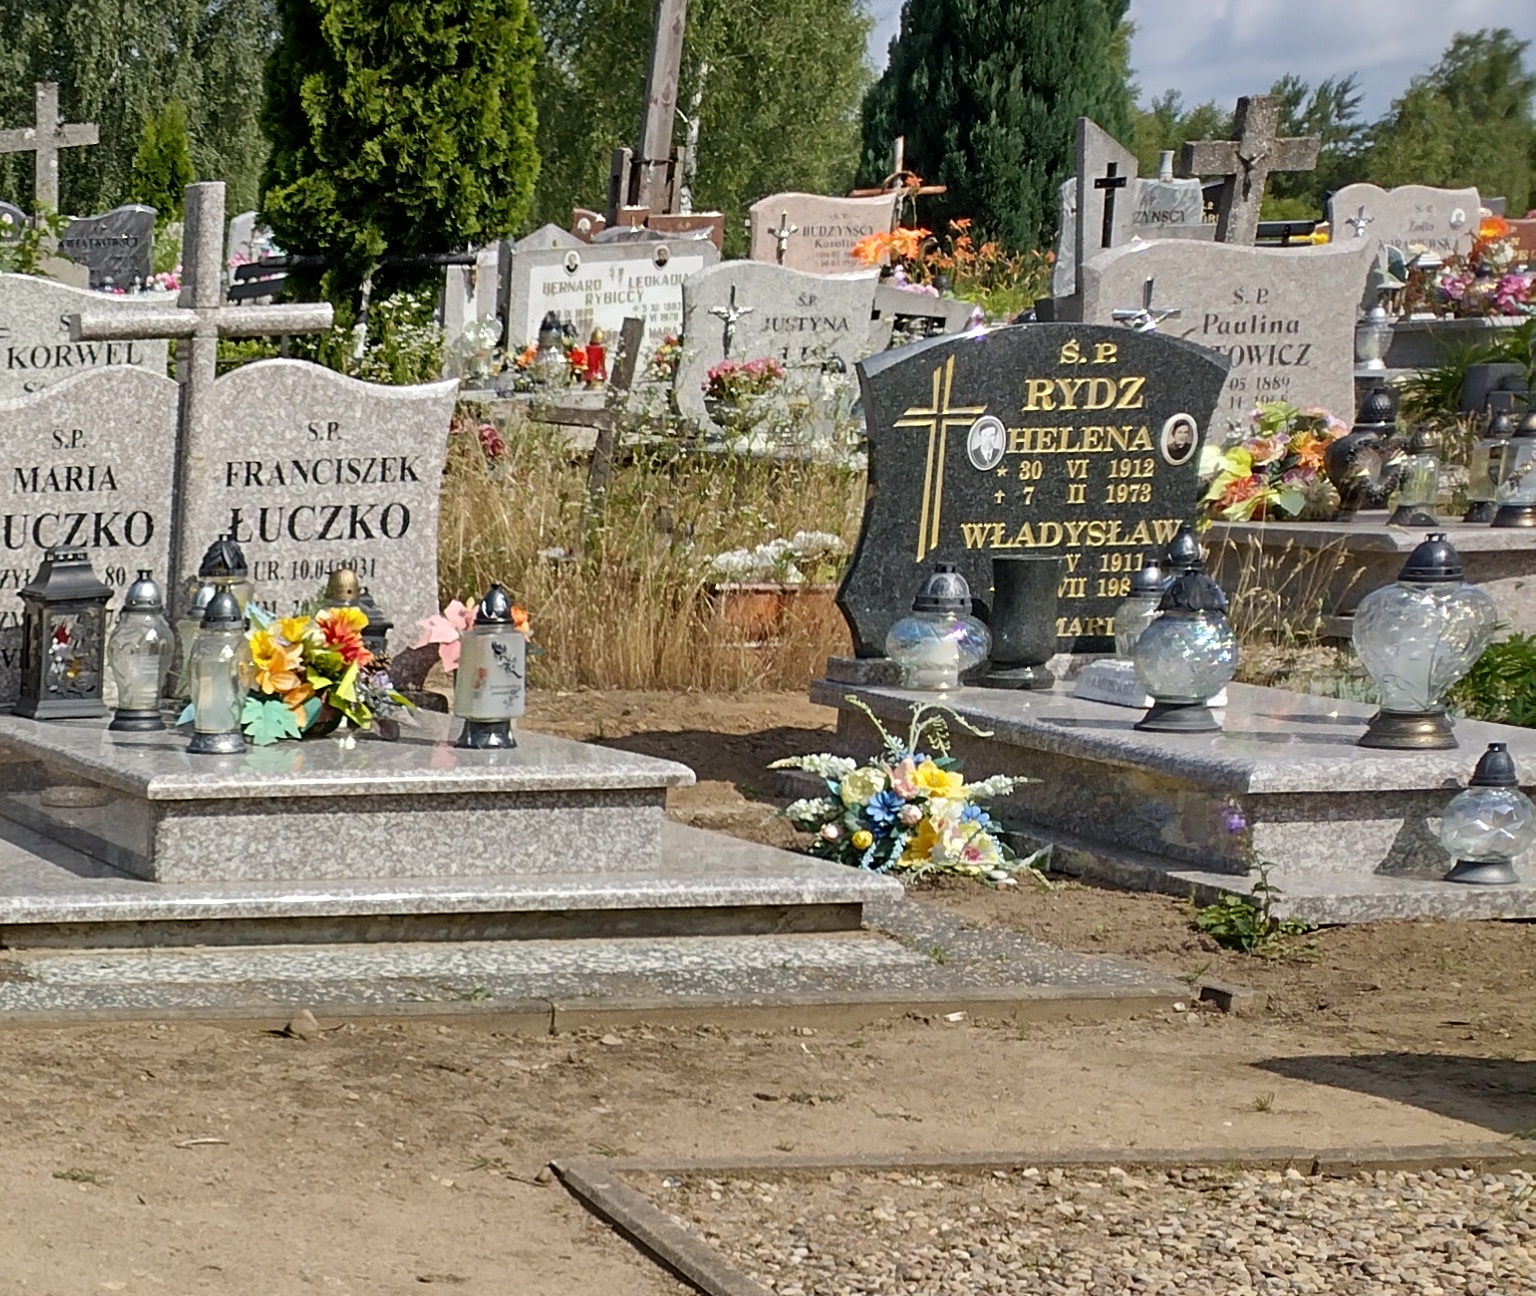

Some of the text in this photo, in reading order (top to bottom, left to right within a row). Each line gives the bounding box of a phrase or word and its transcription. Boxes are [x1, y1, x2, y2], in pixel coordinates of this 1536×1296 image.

[1202, 313, 1301, 336] Paulina
[6, 342, 144, 371] KORWEL
[1021, 375, 1147, 412] RYDZ
[1005, 424, 1156, 455] HELENA
[12, 464, 119, 495] MARIA
[225, 455, 423, 488] FRANCISZEK
[1018, 460, 1044, 481] 30
[1108, 457, 1156, 480] 1912
[1104, 482, 1153, 504] 1973
[228, 502, 411, 544] ŁUCZKO
[959, 518, 1184, 550] WŁADYSŁAW
